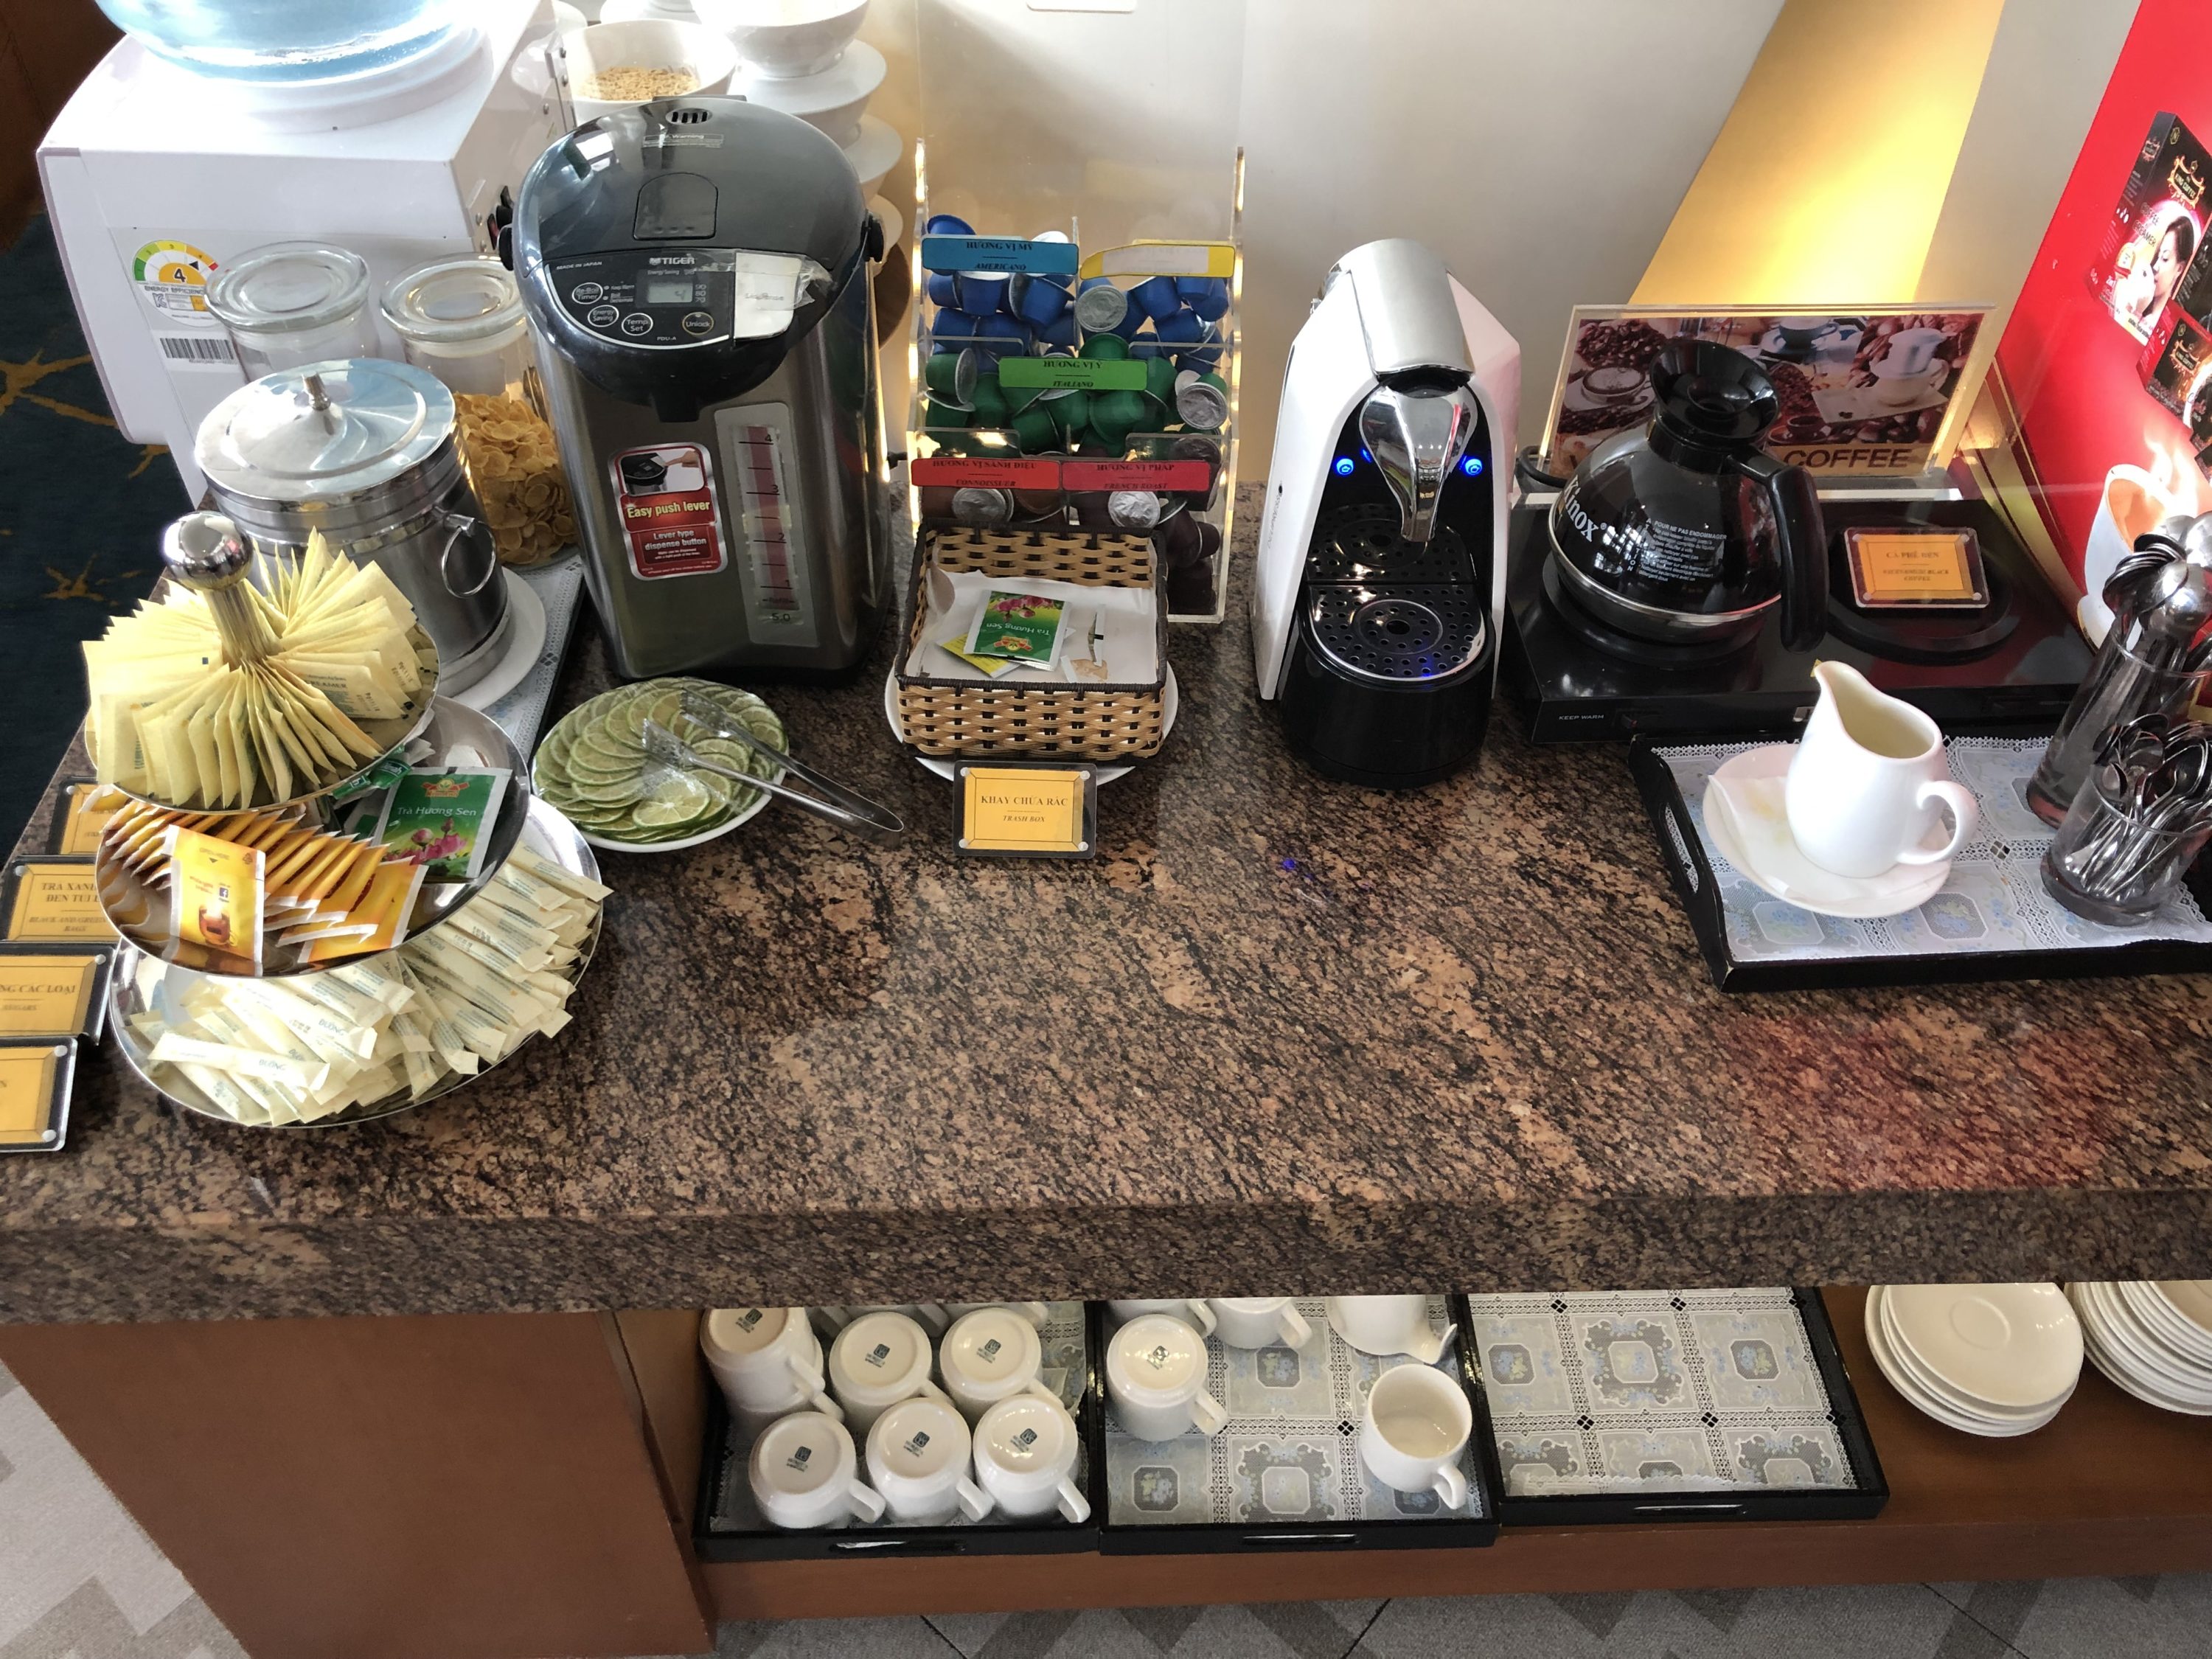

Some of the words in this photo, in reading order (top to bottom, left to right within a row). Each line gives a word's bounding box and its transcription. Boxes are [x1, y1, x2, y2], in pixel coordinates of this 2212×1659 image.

[662, 257, 695, 265] TIGER
[973, 262, 1027, 271] AMERICANO
[174, 268, 187, 283] 4
[576, 286, 599, 294] Re-Boil
[592, 309, 615, 317] Energy
[686, 320, 711, 328] Unlock
[765, 434, 773, 442] 4
[1784, 448, 1913, 469] COFFEE
[771, 484, 779, 494] 3
[627, 506, 652, 519] Easy
[655, 502, 681, 516] push
[683, 501, 711, 512] lever
[653, 532, 675, 540] Lever
[678, 529, 695, 538] type
[1655, 520, 1670, 530] POUR
[1678, 526, 1689, 535] PAS
[1689, 530, 1728, 540] ENDOMMAGER
[778, 532, 785, 541] 2
[644, 540, 681, 552] dispense
[681, 538, 706, 546] button
[785, 580, 790, 588] 1
[306, 680, 348, 689] REAMER
[981, 795, 1010, 804] KHAY
[455, 807, 478, 816] Sen
[1029, 815, 1046, 823] BOX
